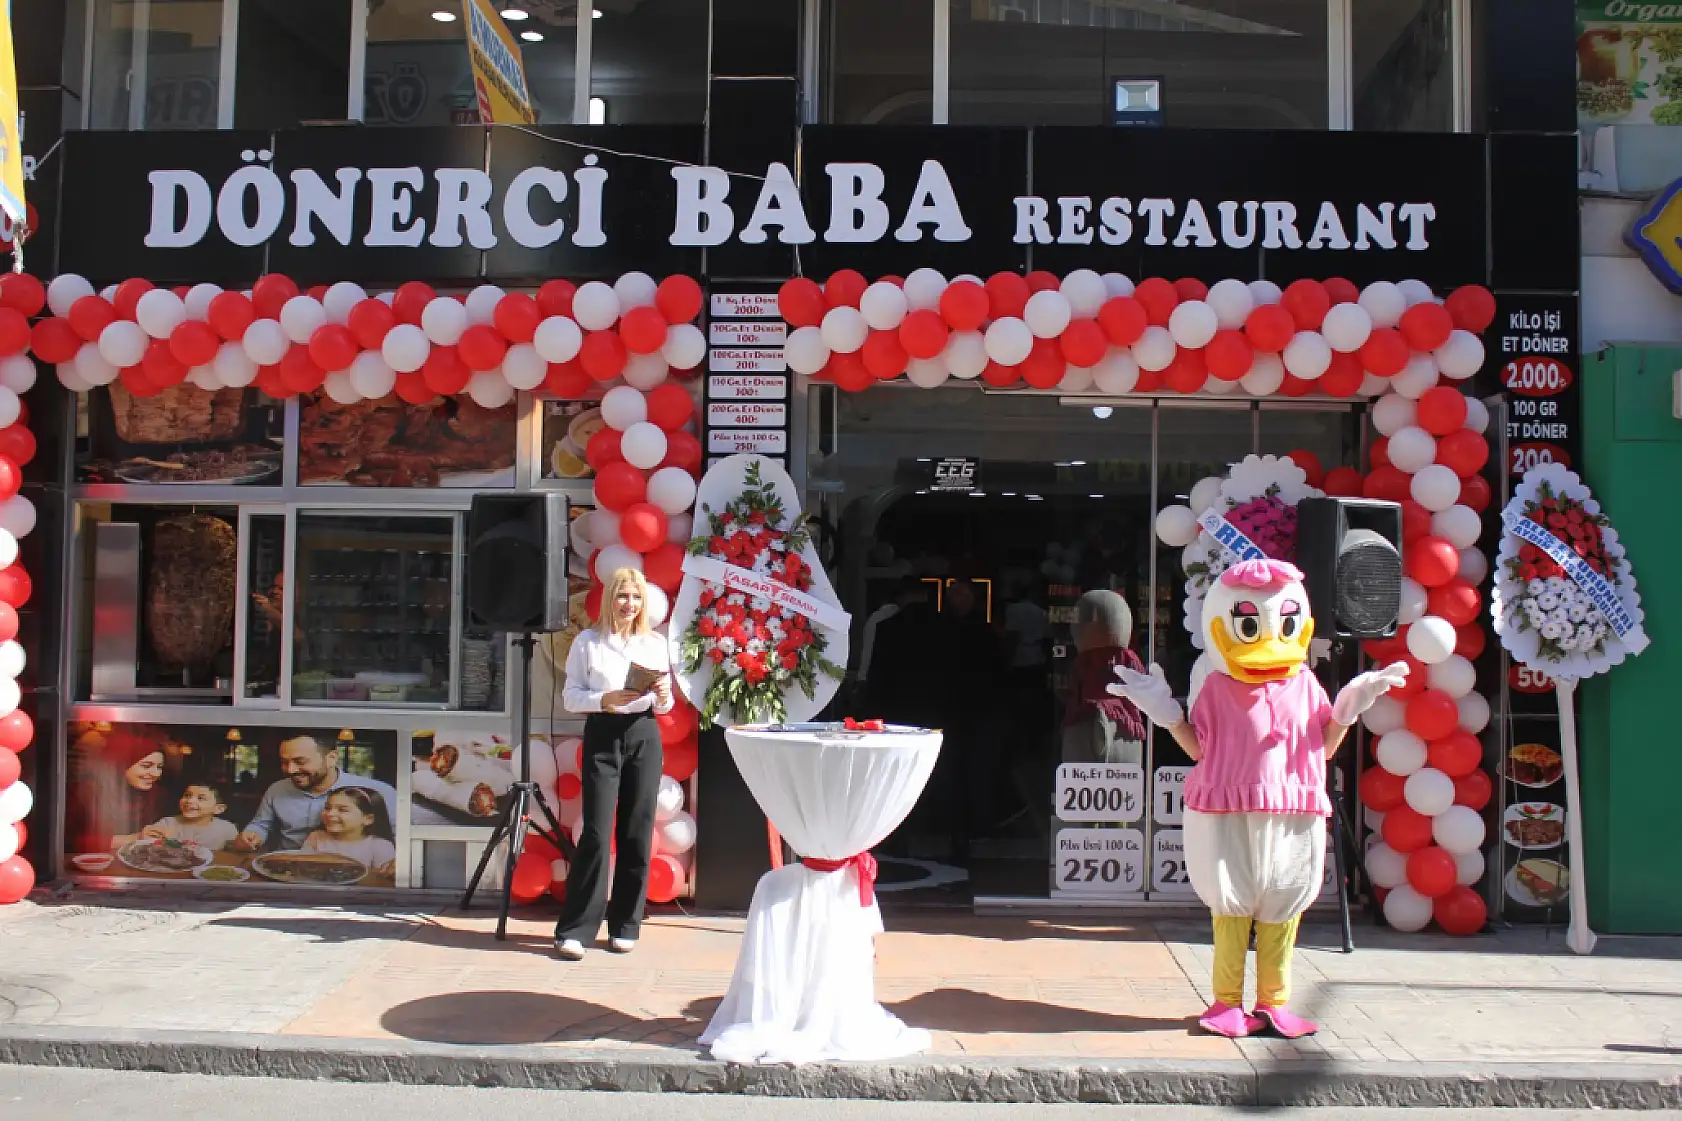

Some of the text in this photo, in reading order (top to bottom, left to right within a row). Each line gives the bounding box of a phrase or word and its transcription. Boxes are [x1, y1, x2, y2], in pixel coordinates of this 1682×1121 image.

[143, 149, 1437, 252] DÖNERCİ BABA RESTAURANT
[1509, 310, 1560, 332] KİLO İŞİ
[1502, 333, 1569, 353] ET DÖNER
[1513, 400, 1558, 416] 100 GR
[1522, 419, 1568, 438] DÖNER
